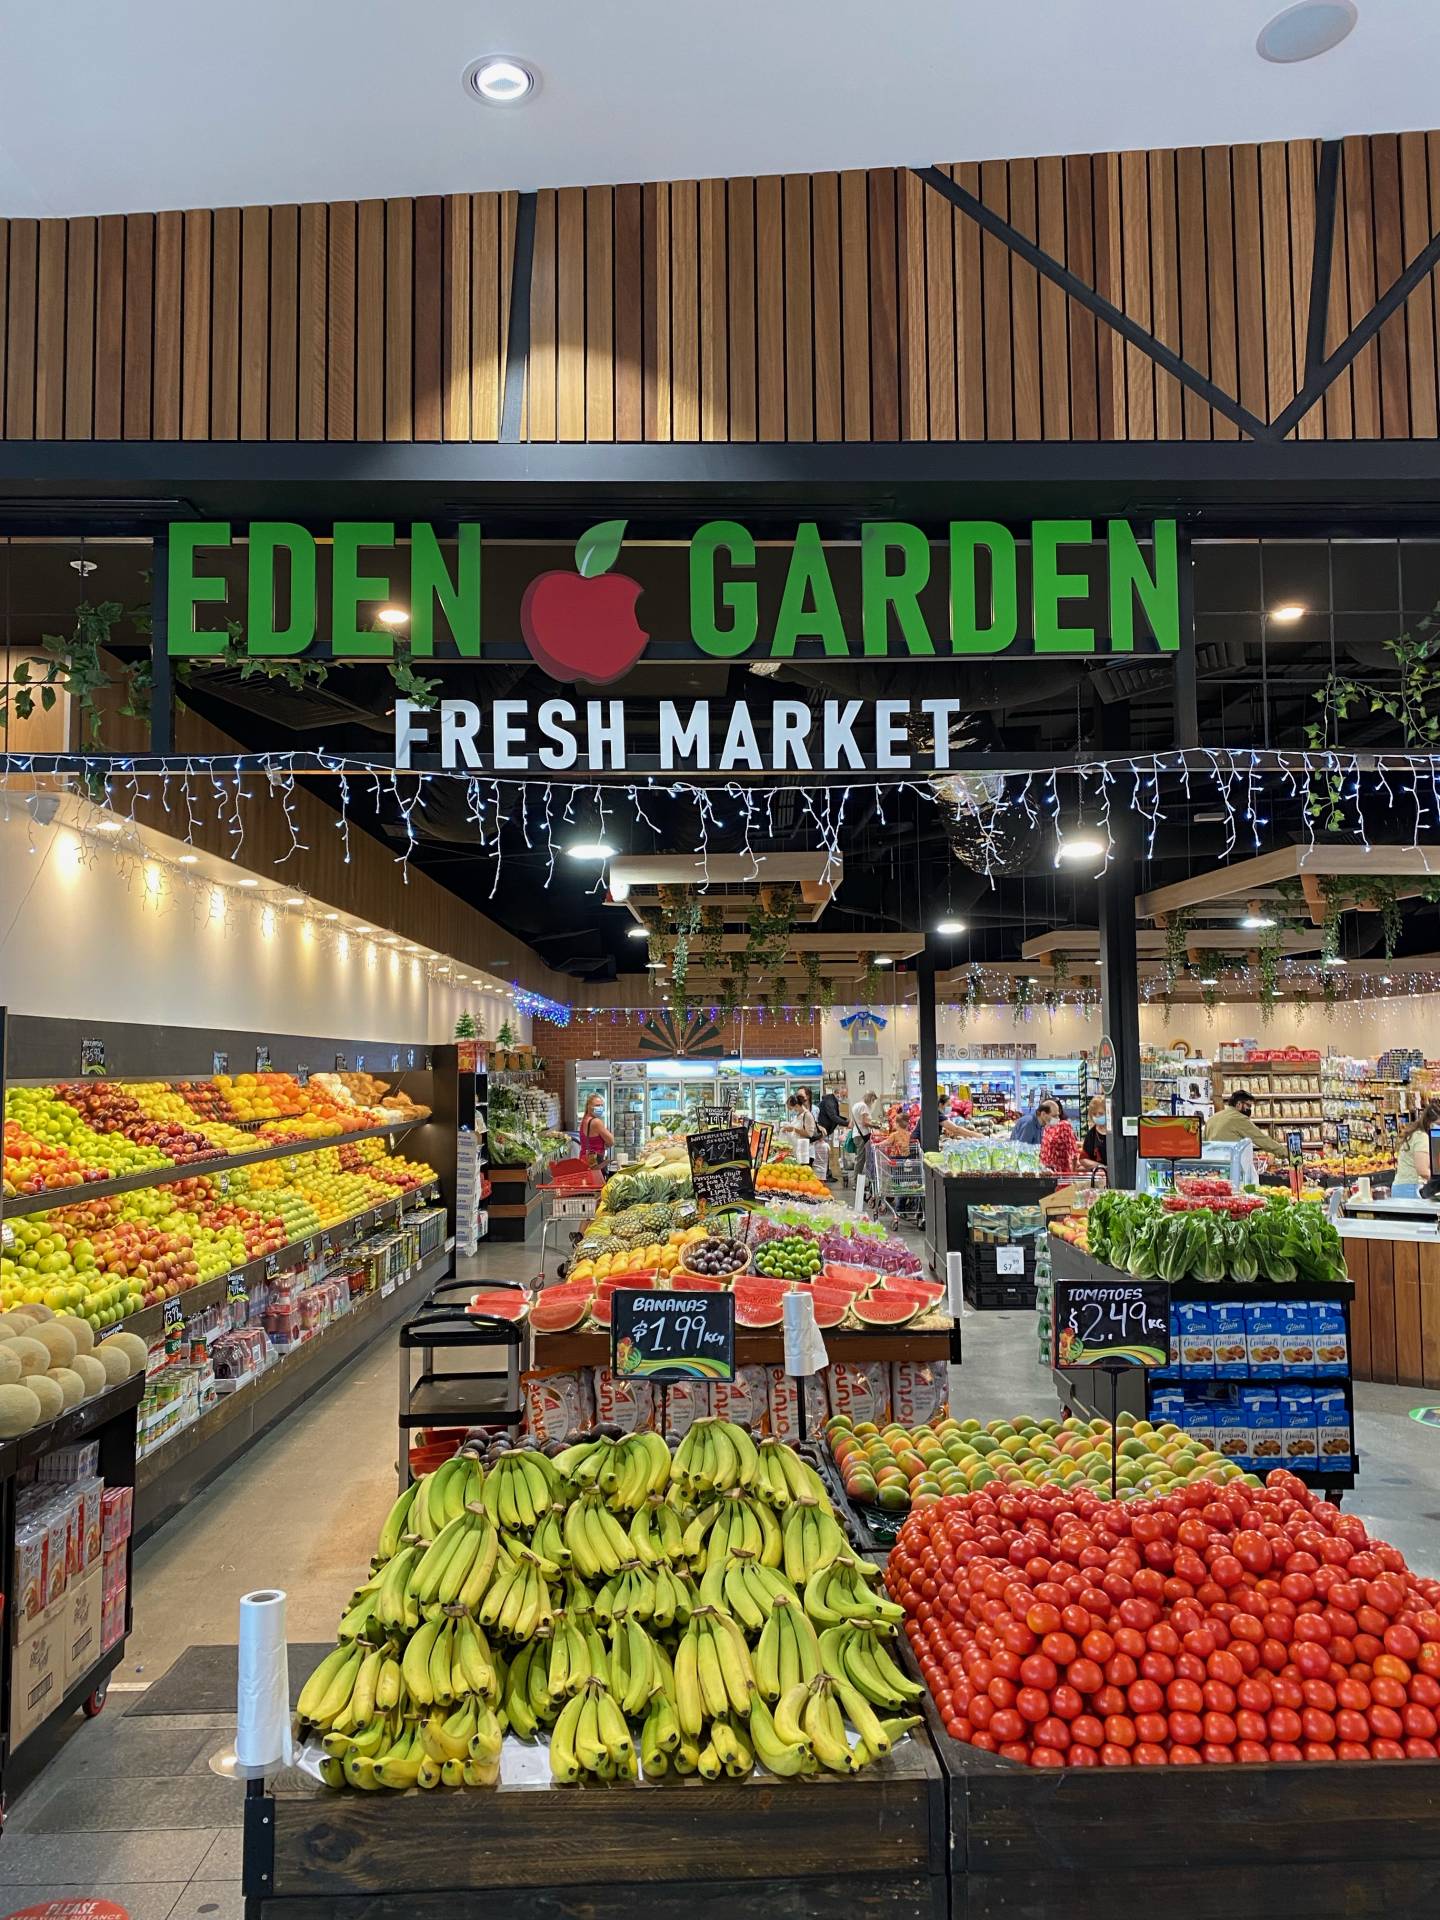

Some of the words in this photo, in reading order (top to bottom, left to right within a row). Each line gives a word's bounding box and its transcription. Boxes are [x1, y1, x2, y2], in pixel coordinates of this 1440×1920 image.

[168, 522, 481, 657] EDEN
[690, 520, 1181, 658] GARDEN
[395, 698, 627, 770] FRESH
[659, 698, 960, 769] MARKET
[632, 1297, 708, 1312] BANANAS
[1067, 1288, 1143, 1301] TOMATOES
[1068, 1301, 1148, 1342] $2.49
[631, 1315, 707, 1351] $1.99
[599, 1369, 616, 1424] rtune
[771, 1368, 791, 1436] ortune
[834, 1362, 853, 1420] rtune
[897, 1360, 914, 1425] fortun
[45, 1902, 100, 1915] PLEASE
